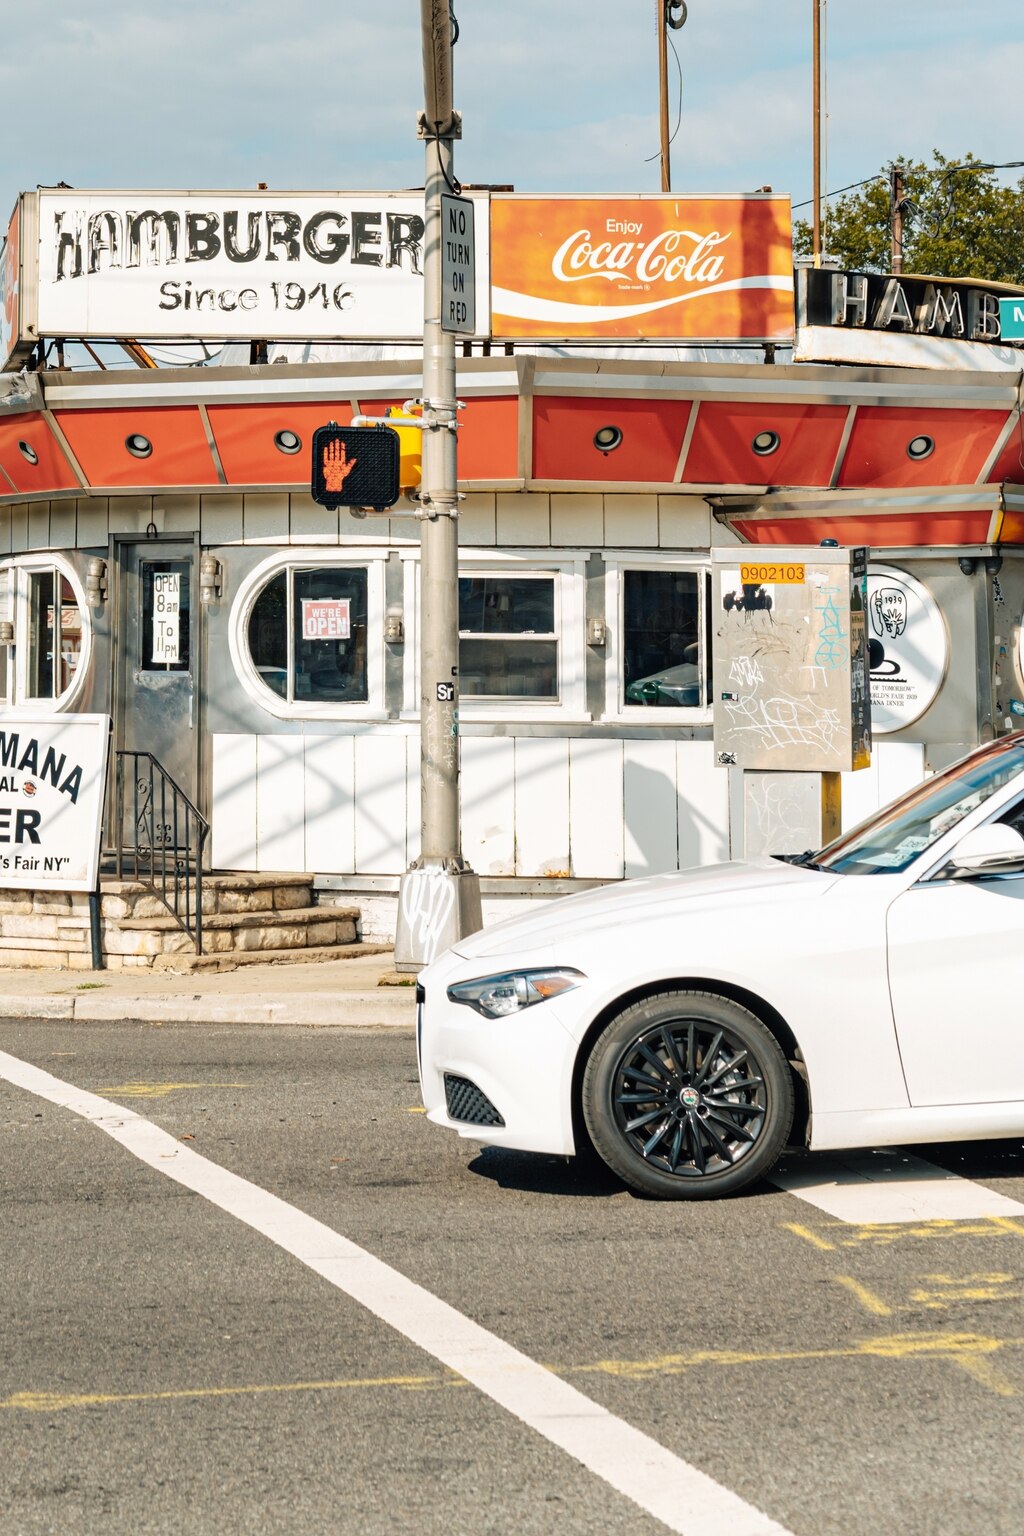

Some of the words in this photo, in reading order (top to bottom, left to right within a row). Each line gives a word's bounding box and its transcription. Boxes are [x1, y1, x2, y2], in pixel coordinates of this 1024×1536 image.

[449, 208, 466, 236] NO
[606, 218, 643, 235] Enjoy
[52, 209, 424, 283] HAMBURGER
[446, 241, 470, 266] TURN
[551, 229, 732, 282] Coca-Cola
[452, 271, 465, 293] ON
[158, 280, 260, 311] Since
[450, 300, 467, 322] RED
[832, 274, 1001, 340] HAMB
[740, 566, 805, 580] 0902103
[155, 575, 178, 593] OPEN
[885, 595, 902, 604] 1939
[311, 607, 341, 618] WE'RE
[307, 617, 348, 636] OPEN
[437, 683, 454, 700] Sr
[14, 854, 40, 871] Fair
[44, 856, 70, 873] NY"
